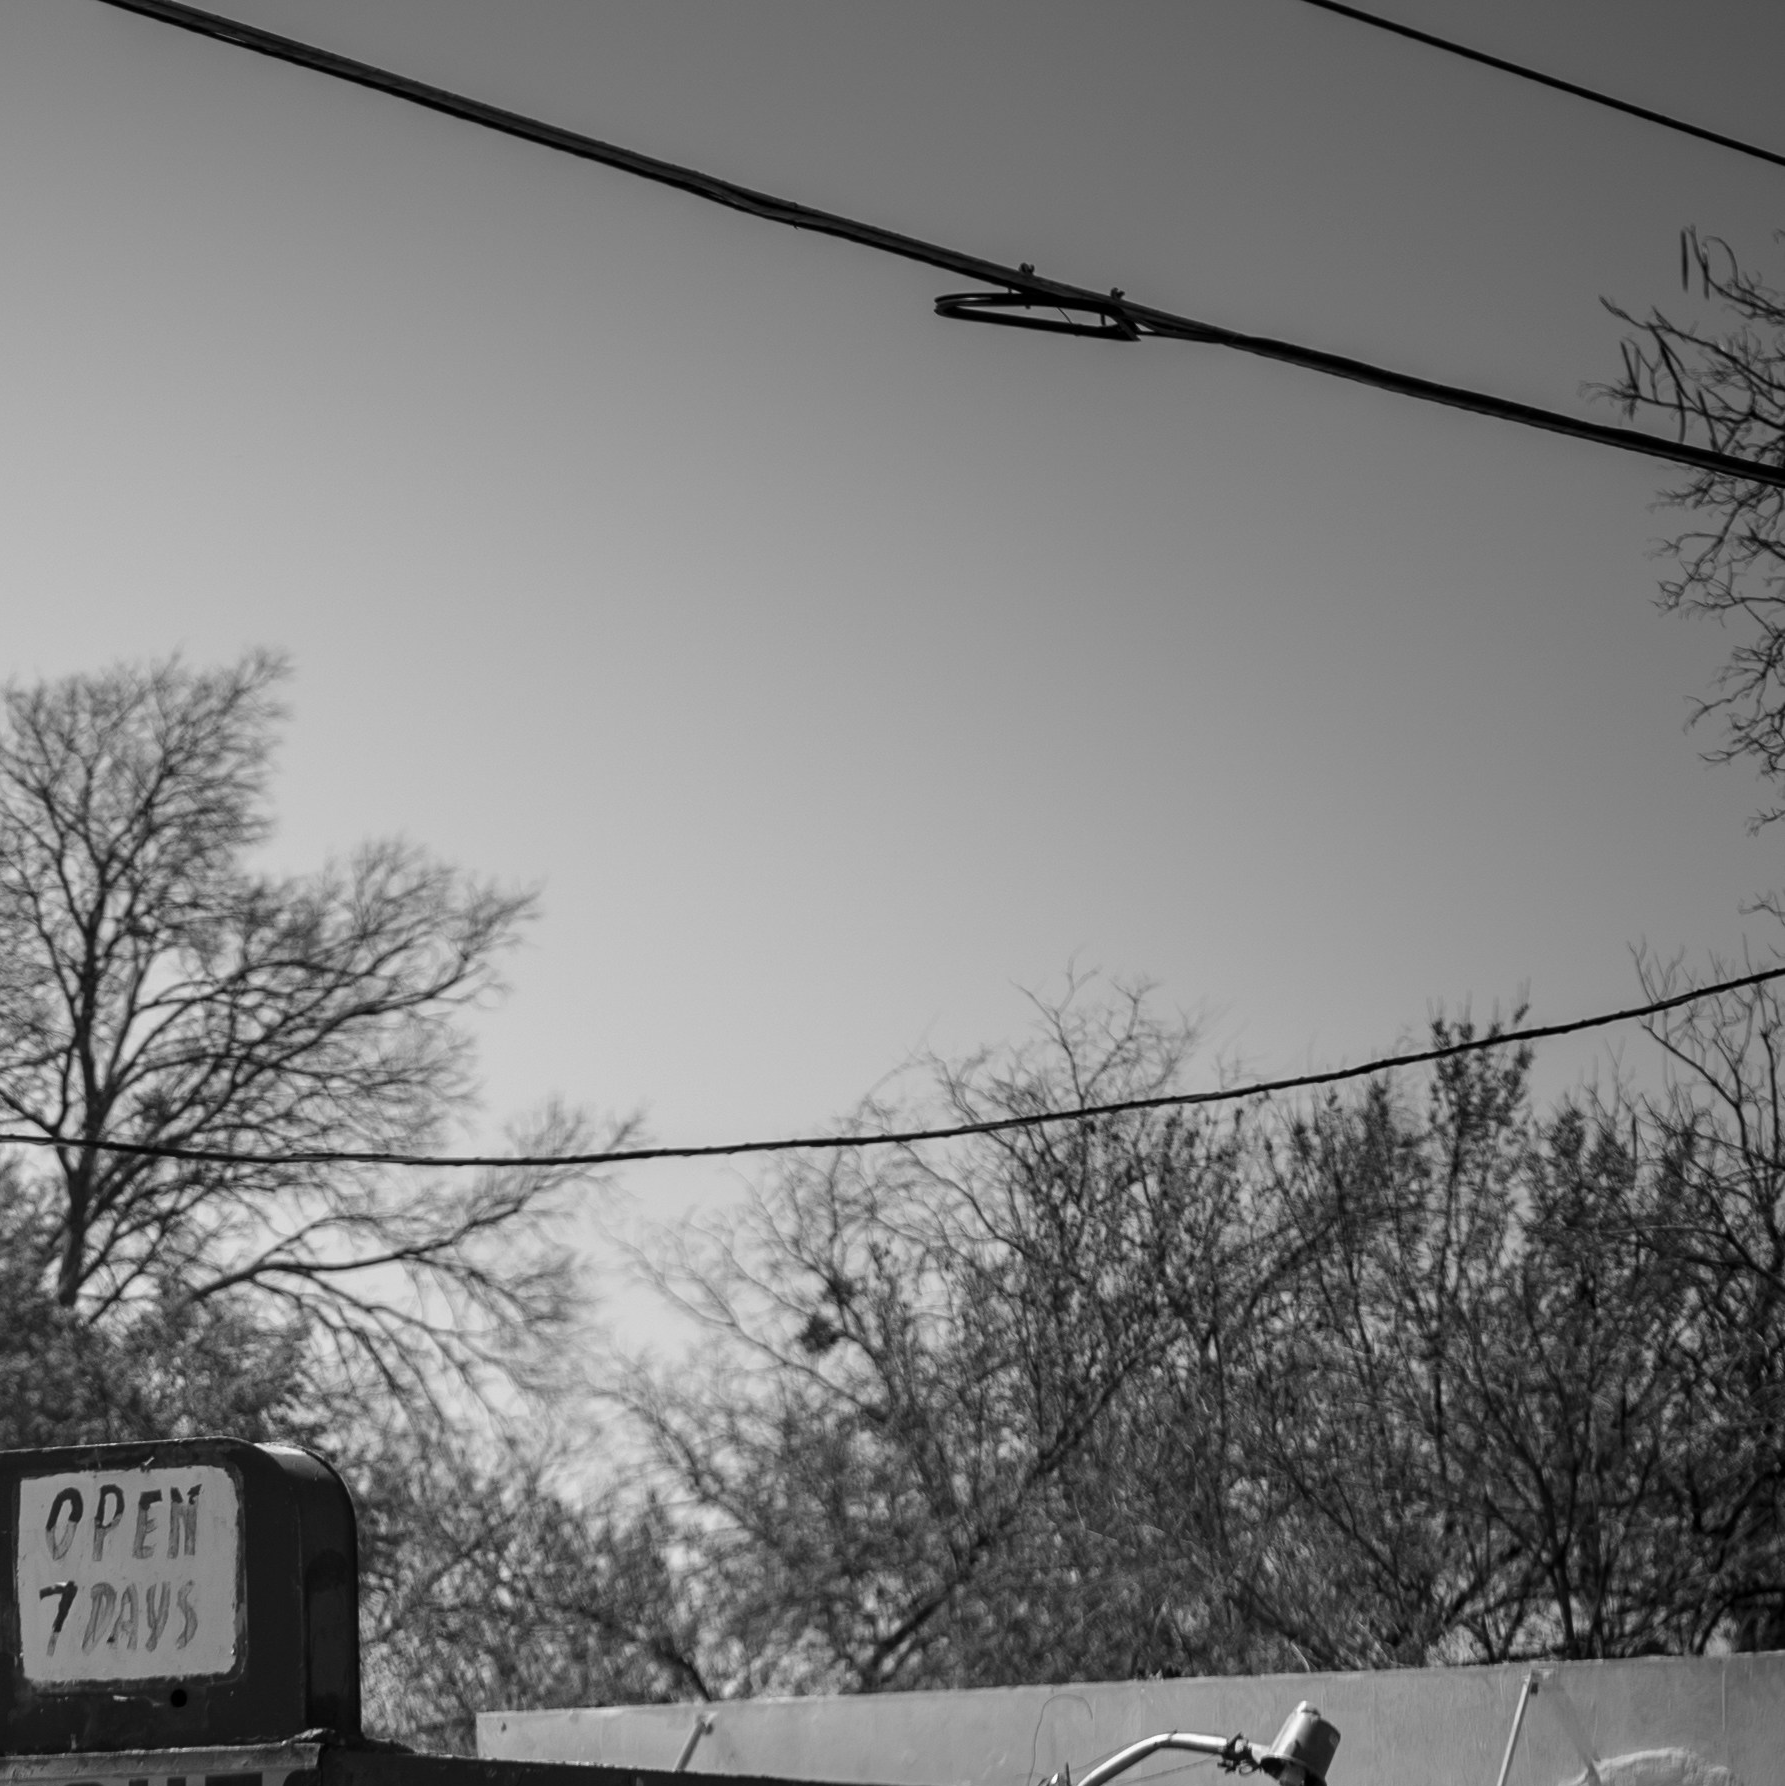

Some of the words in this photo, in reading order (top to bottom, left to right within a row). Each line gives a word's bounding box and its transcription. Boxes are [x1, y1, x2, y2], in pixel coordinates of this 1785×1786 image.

[44, 1482, 202, 1562] OPEN
[38, 1579, 78, 1657] 7
[80, 1577, 199, 1654] DAYS
